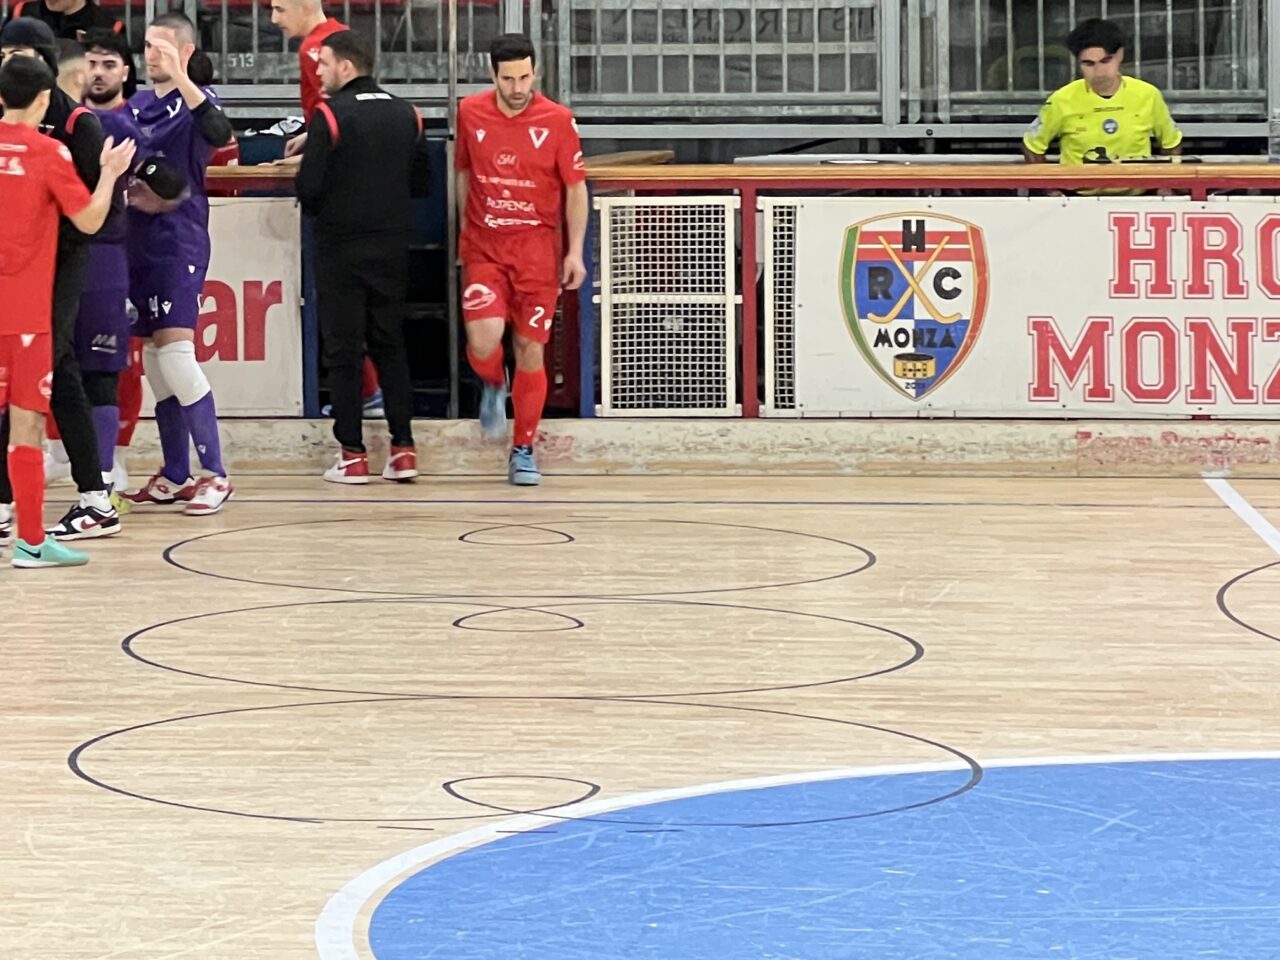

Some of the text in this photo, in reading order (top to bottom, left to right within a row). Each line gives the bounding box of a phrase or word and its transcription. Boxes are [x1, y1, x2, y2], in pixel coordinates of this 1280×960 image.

[902, 219, 925, 253] H
[933, 266, 962, 300] C
[528, 306, 545, 328] 2
[873, 327, 956, 349] MONZA
[1027, 315, 1280, 405] MON
